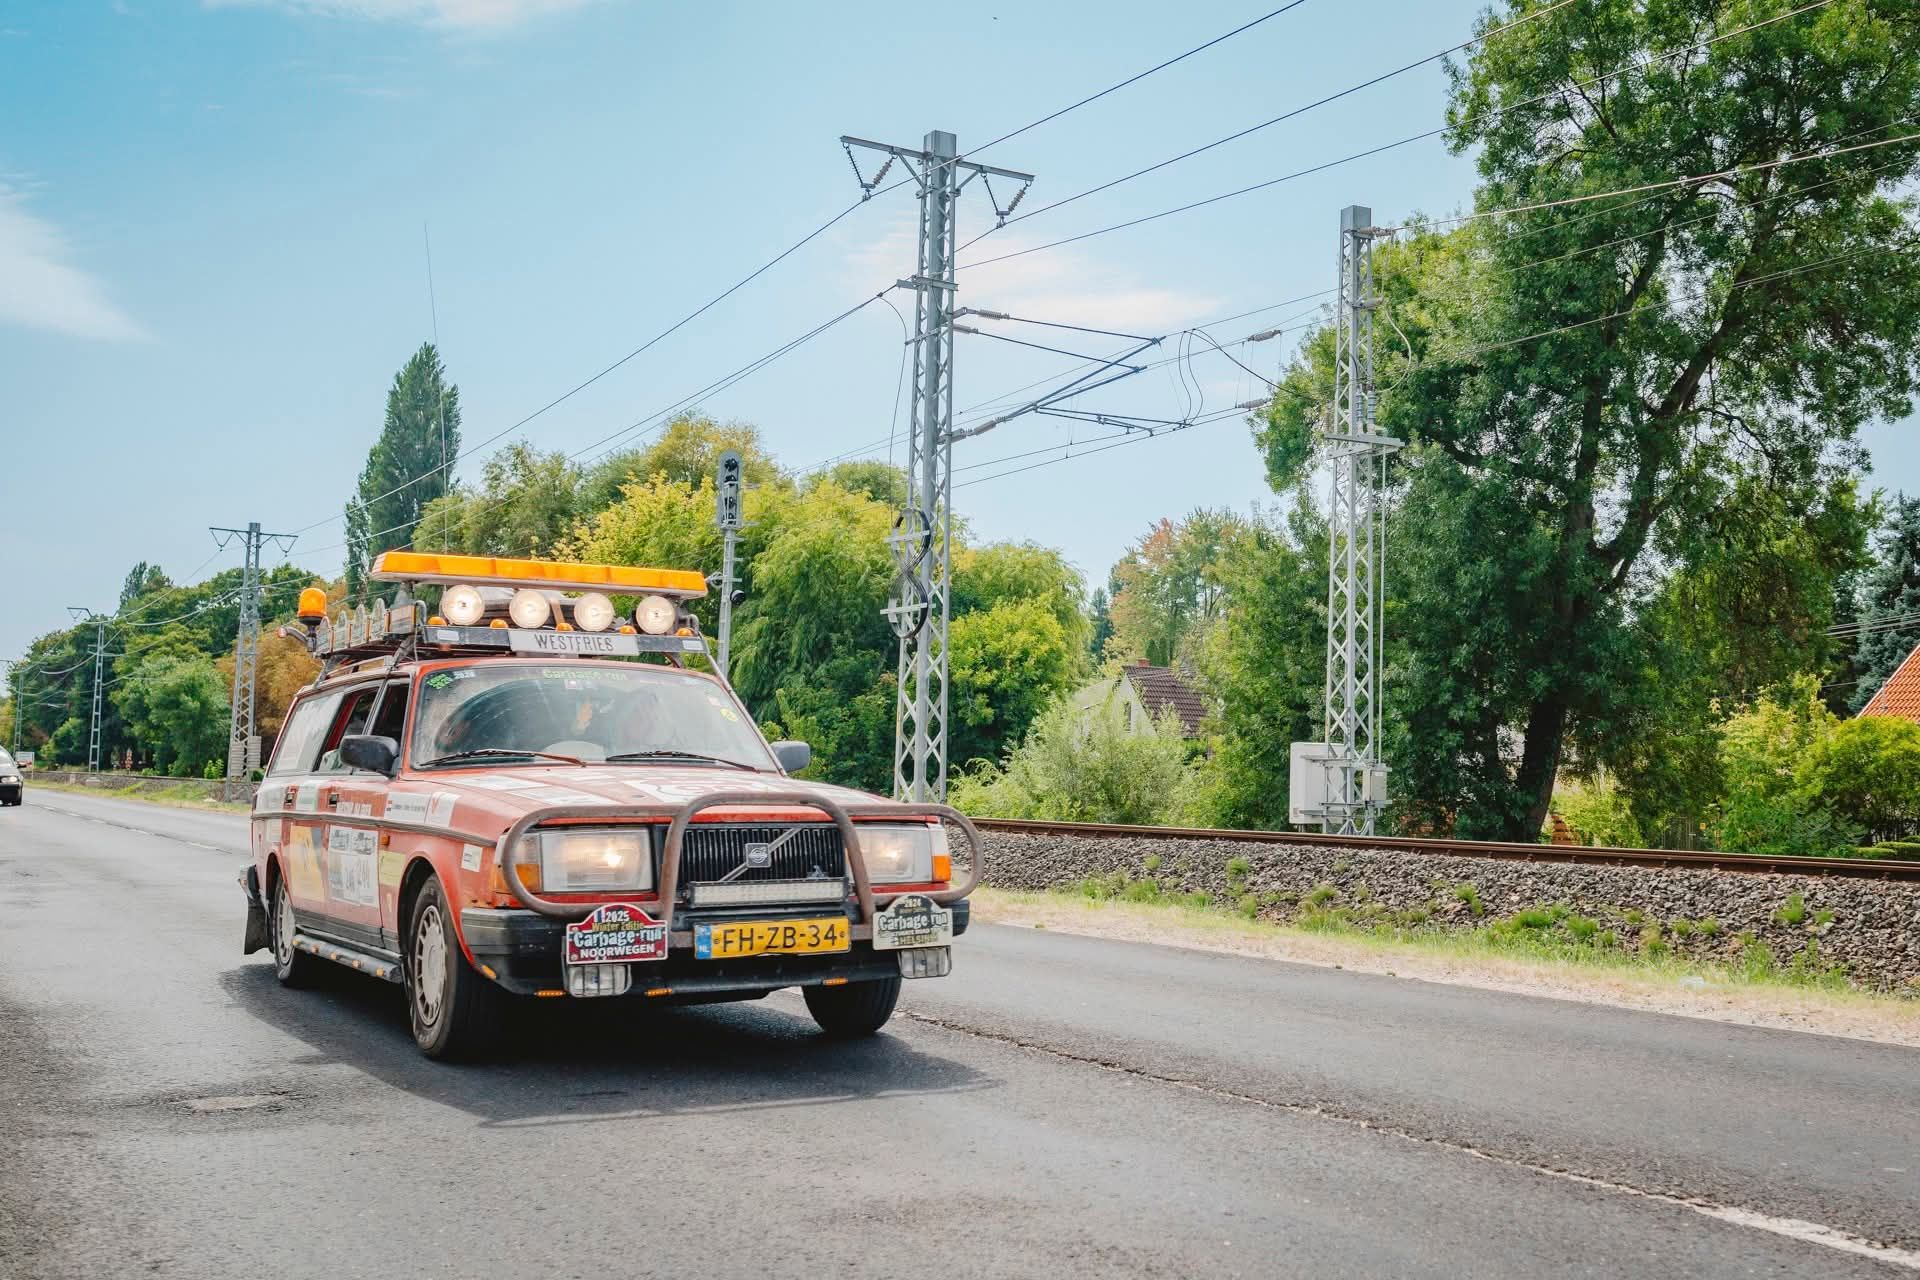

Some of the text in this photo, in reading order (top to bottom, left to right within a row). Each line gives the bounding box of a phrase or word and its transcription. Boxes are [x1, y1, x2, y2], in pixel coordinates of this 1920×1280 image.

[534, 632, 614, 652] WESTFRIES
[606, 911, 630, 922] 2025
[722, 923, 838, 953] FH-ZB-34
[580, 944, 655, 958] NOORWEGEN
